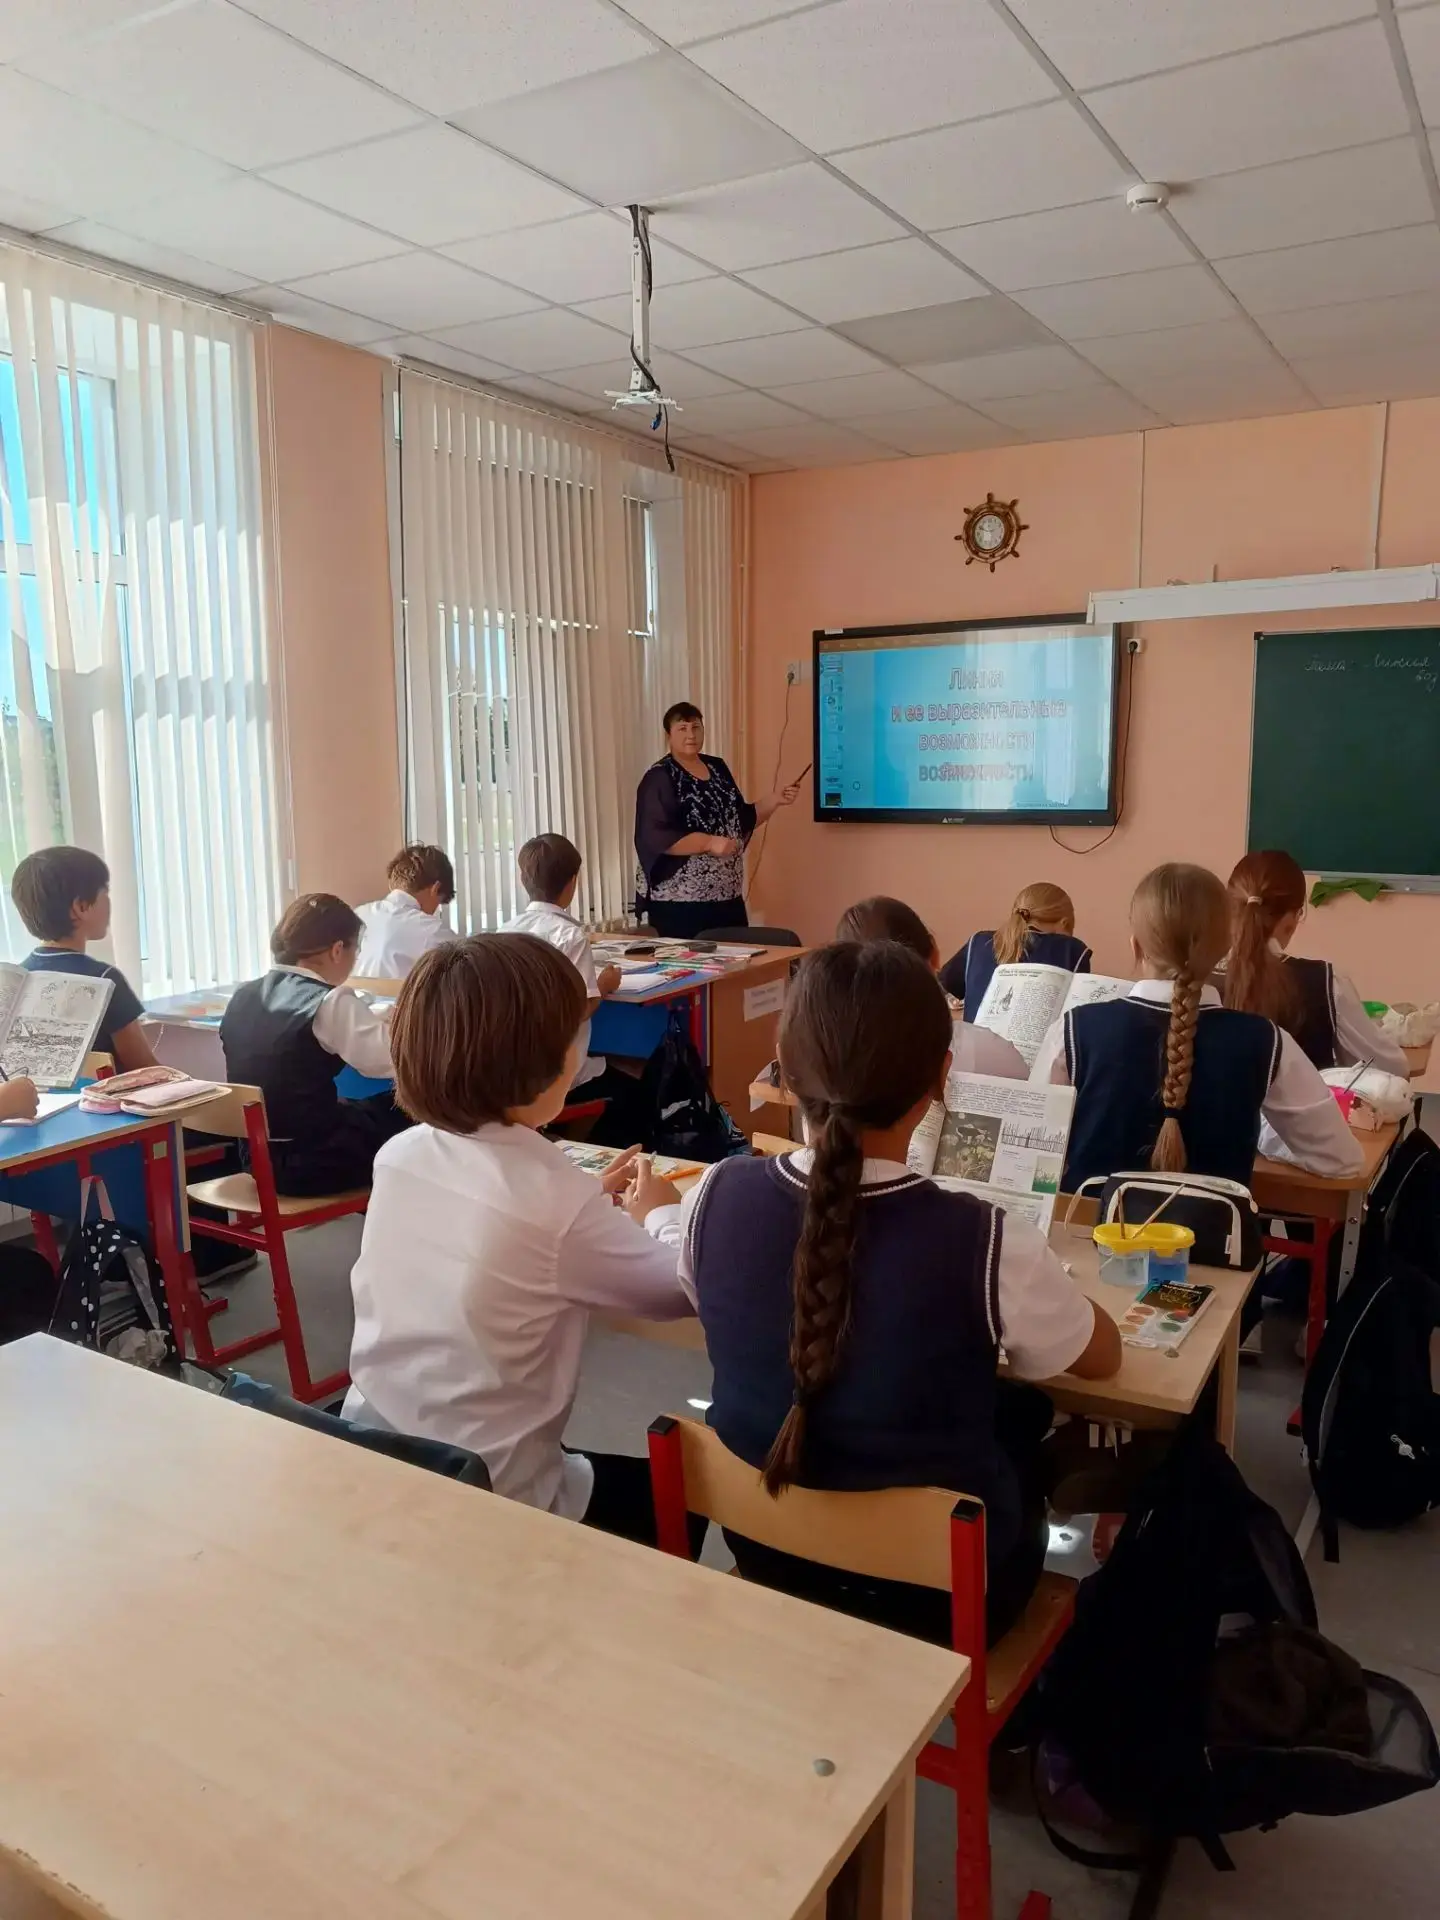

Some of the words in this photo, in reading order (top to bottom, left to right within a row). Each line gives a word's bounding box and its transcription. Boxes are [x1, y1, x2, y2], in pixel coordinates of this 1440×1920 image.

[891, 704, 902, 723] и
[905, 704, 925, 722] ее
[927, 698, 1067, 726] выразительные
[918, 731, 1035, 751] возможности
